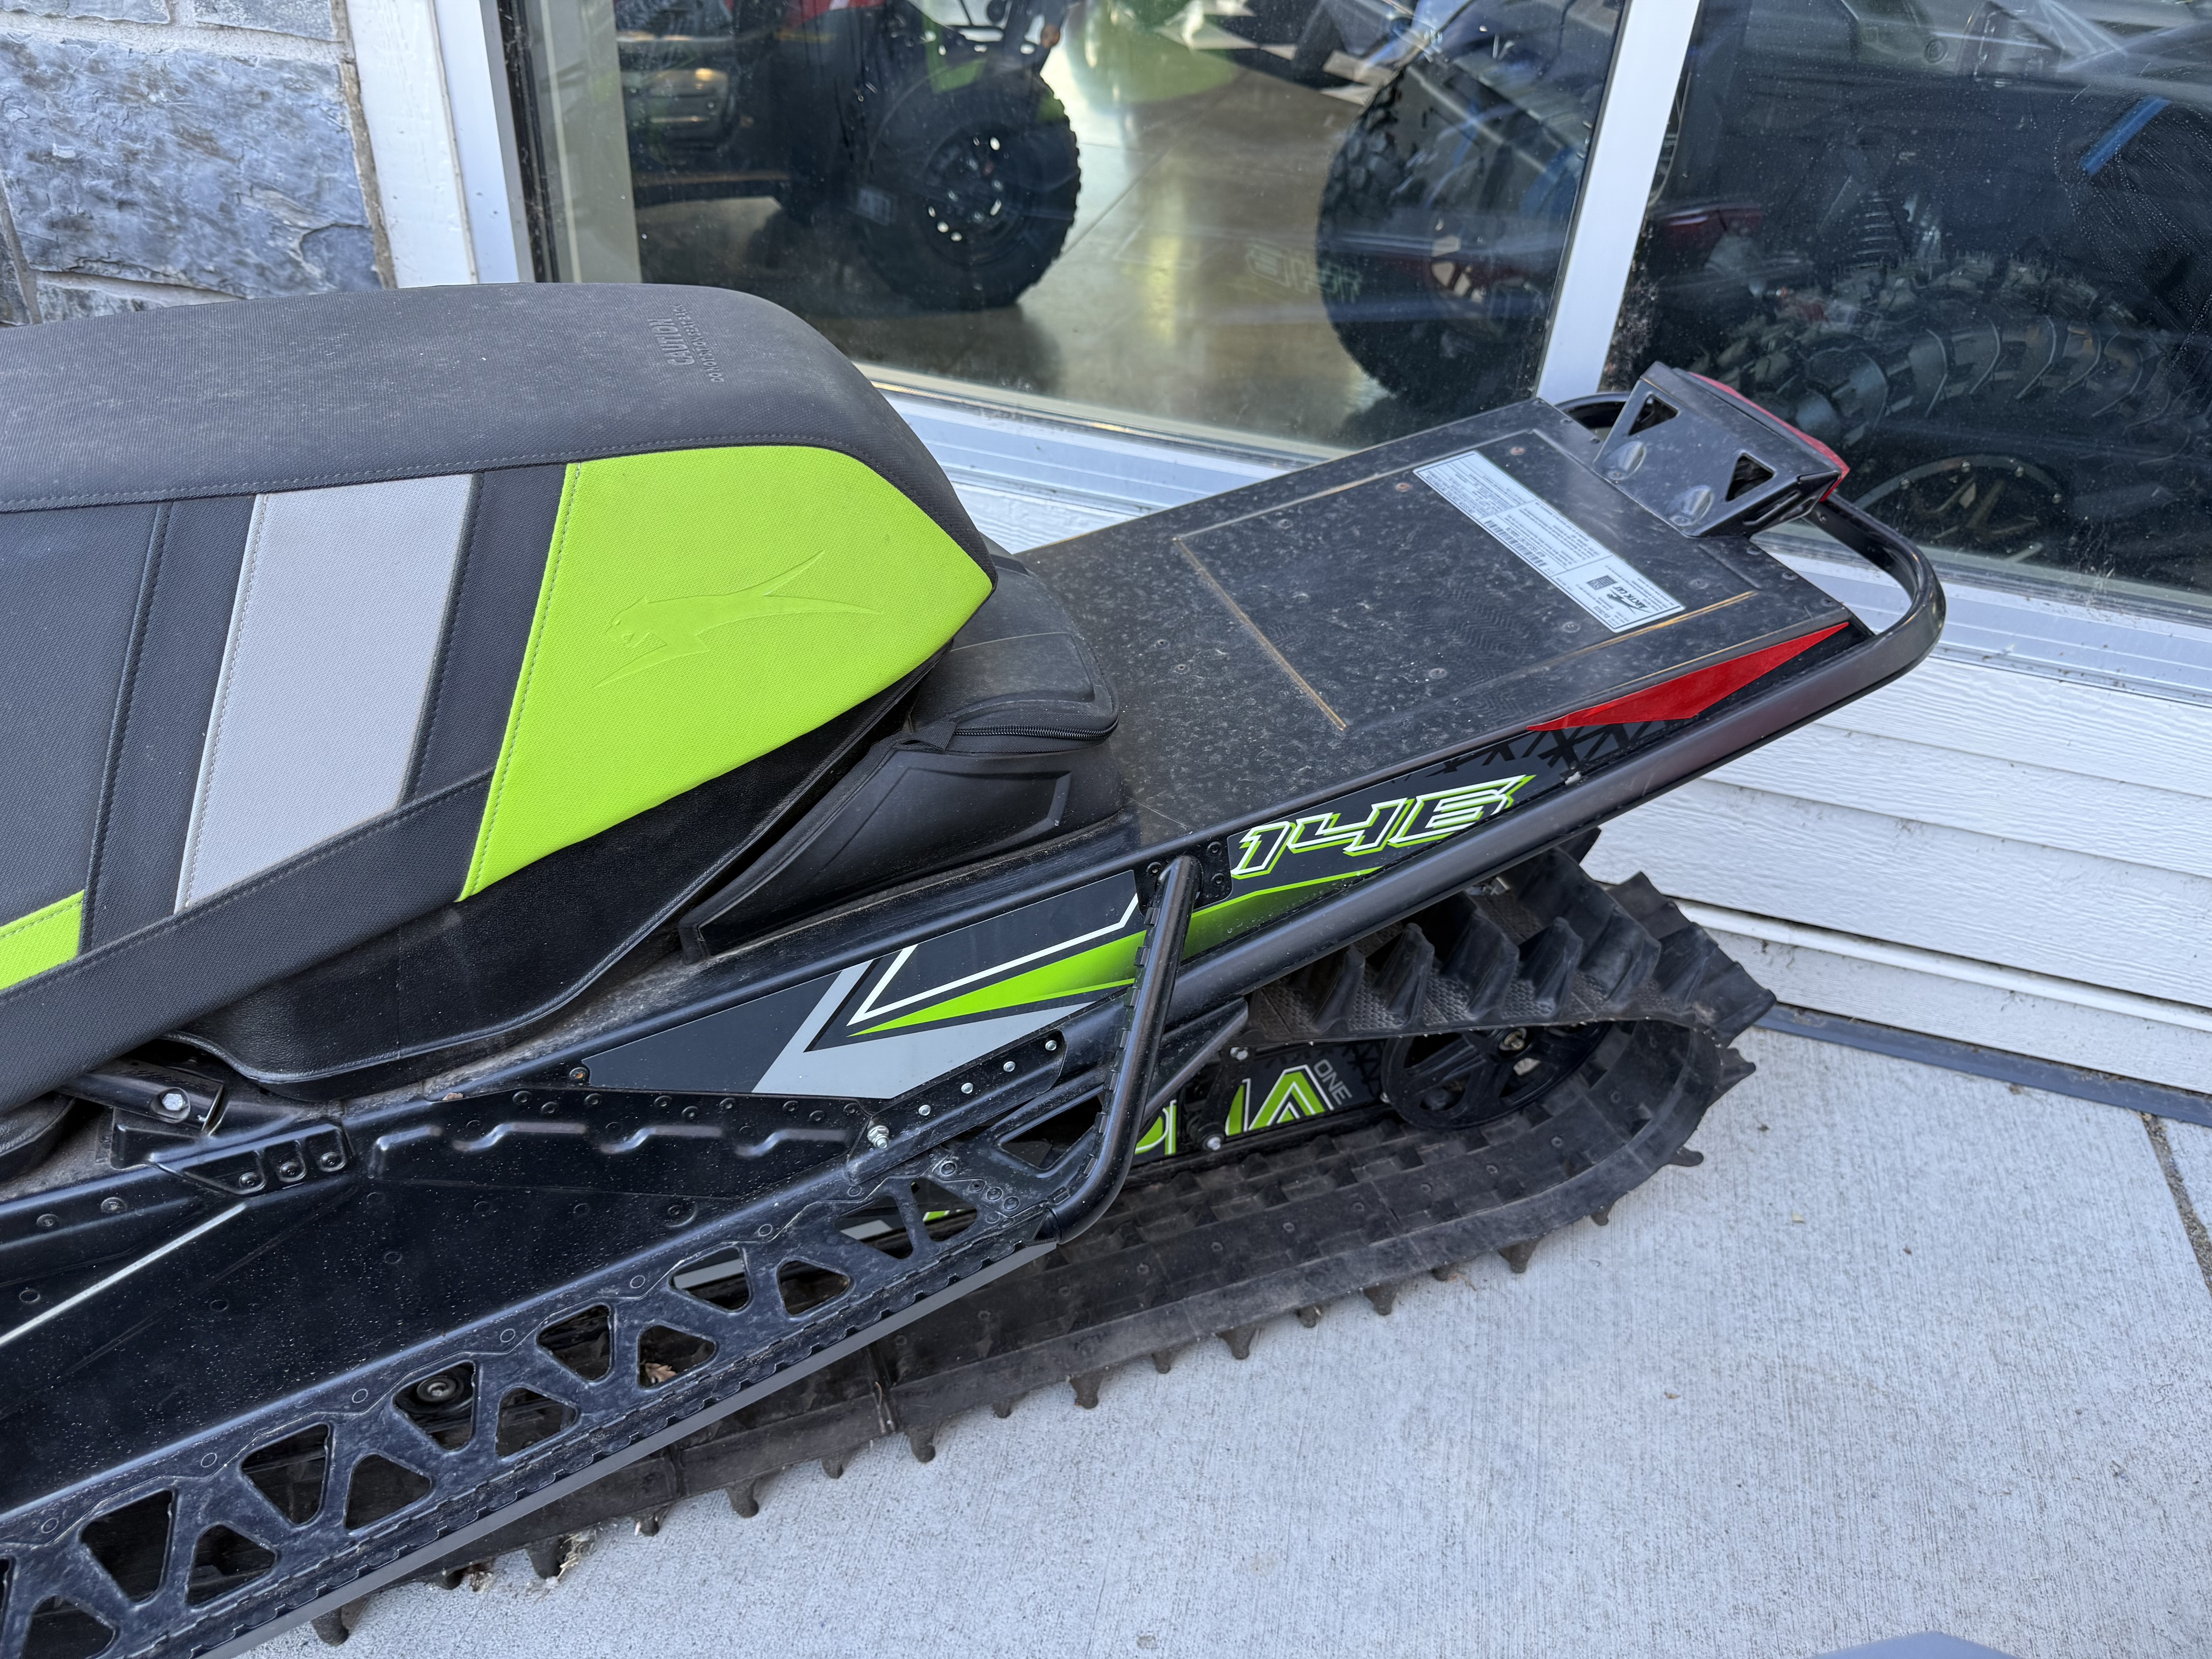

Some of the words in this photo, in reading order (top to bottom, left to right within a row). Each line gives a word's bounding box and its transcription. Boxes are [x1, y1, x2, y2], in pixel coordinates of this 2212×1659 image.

[647, 318, 694, 365] CAUTION
[689, 337, 706, 346] ON
[701, 357, 720, 371] NOT
[708, 372, 724, 382] DO
[1231, 774, 1537, 879] 146
[1314, 1059, 1352, 1105] ONE
